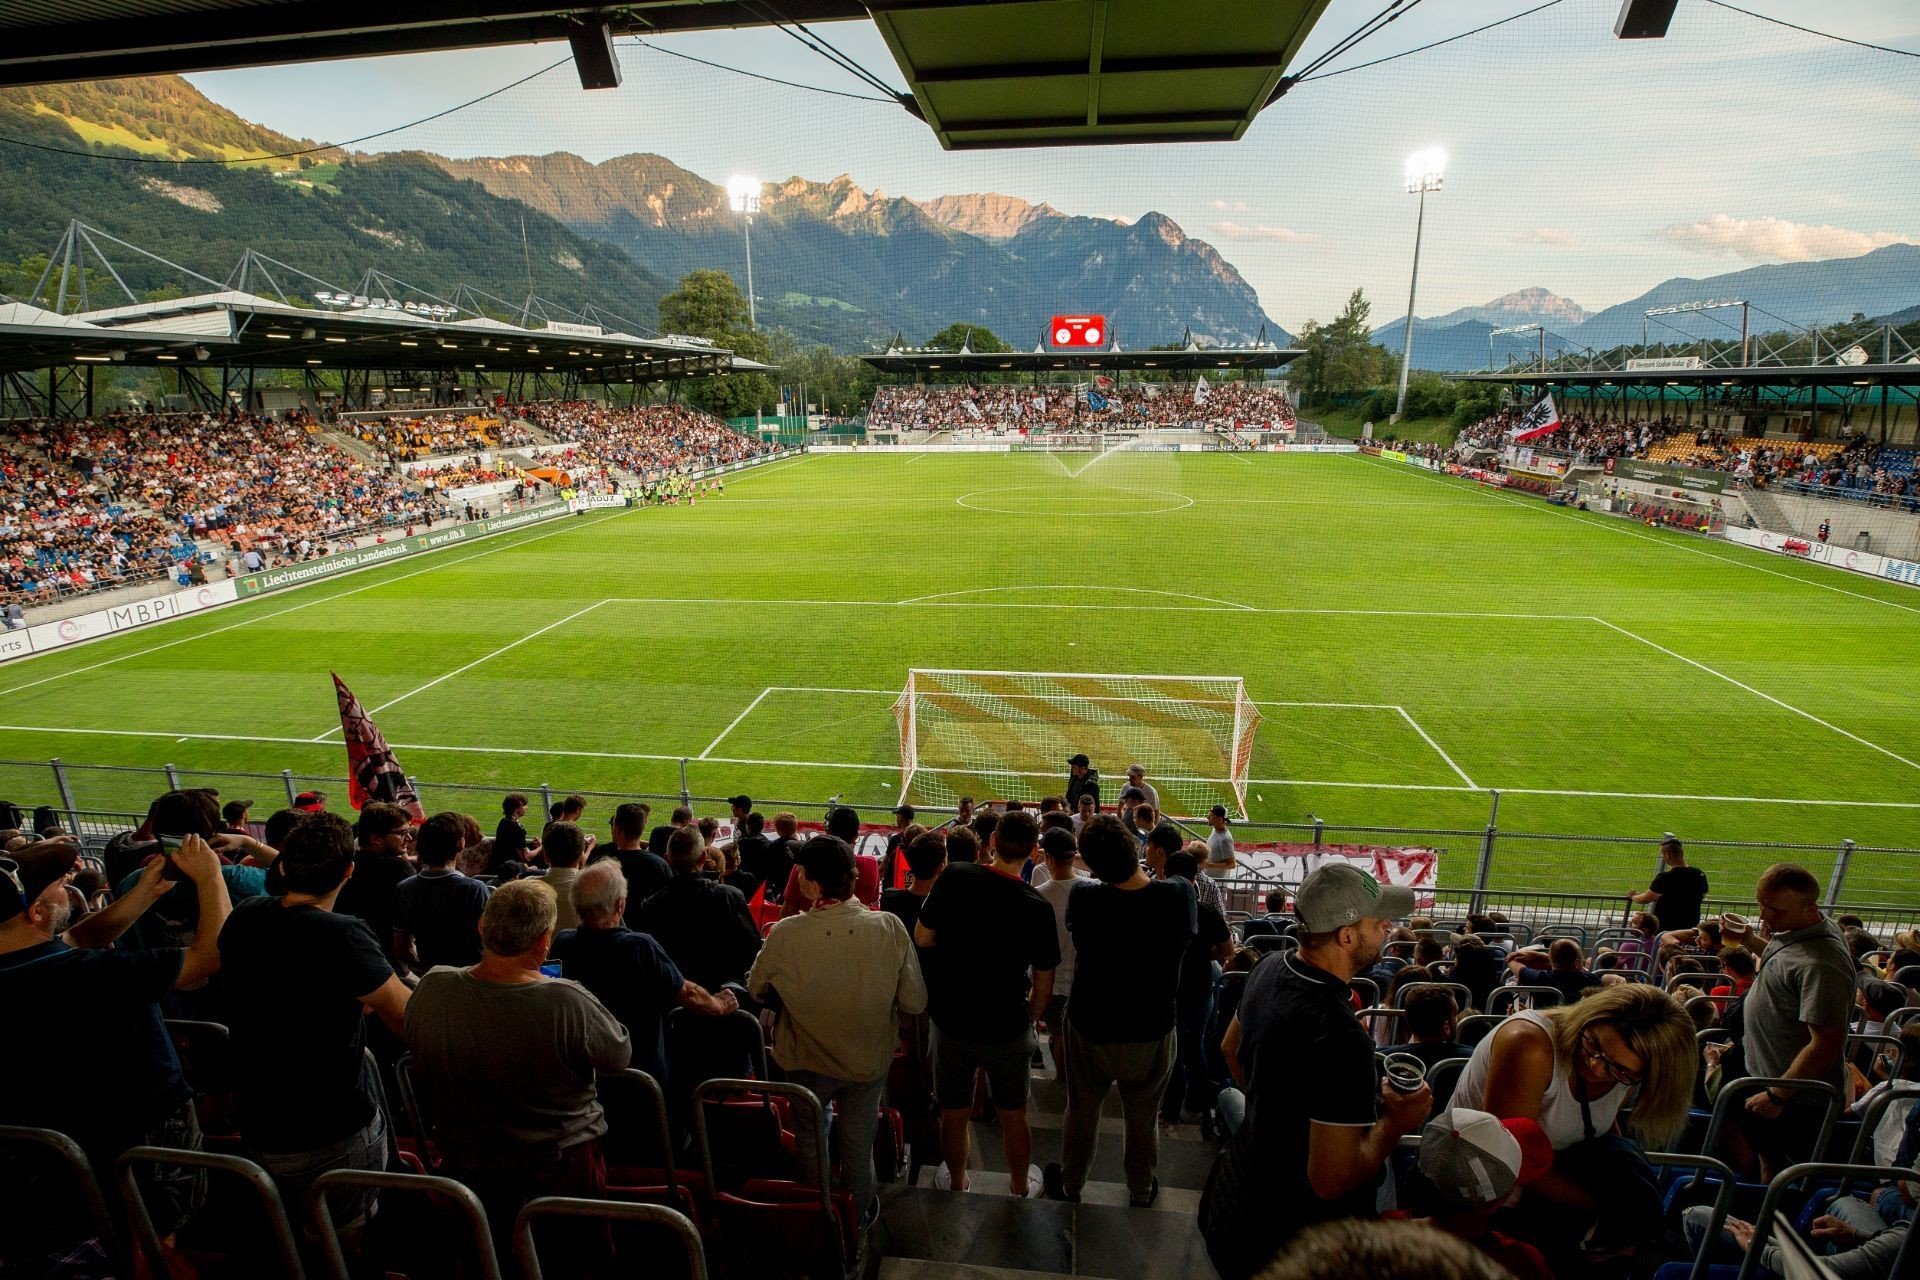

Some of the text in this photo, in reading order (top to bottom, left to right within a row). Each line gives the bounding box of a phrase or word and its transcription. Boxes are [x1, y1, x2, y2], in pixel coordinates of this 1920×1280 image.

[487, 508, 540, 531] Liechtensteinische
[429, 528, 466, 546] www.llb.li
[263, 543, 408, 588] Liechtensteinische Landesbank
[113, 597, 175, 629] MBPI
